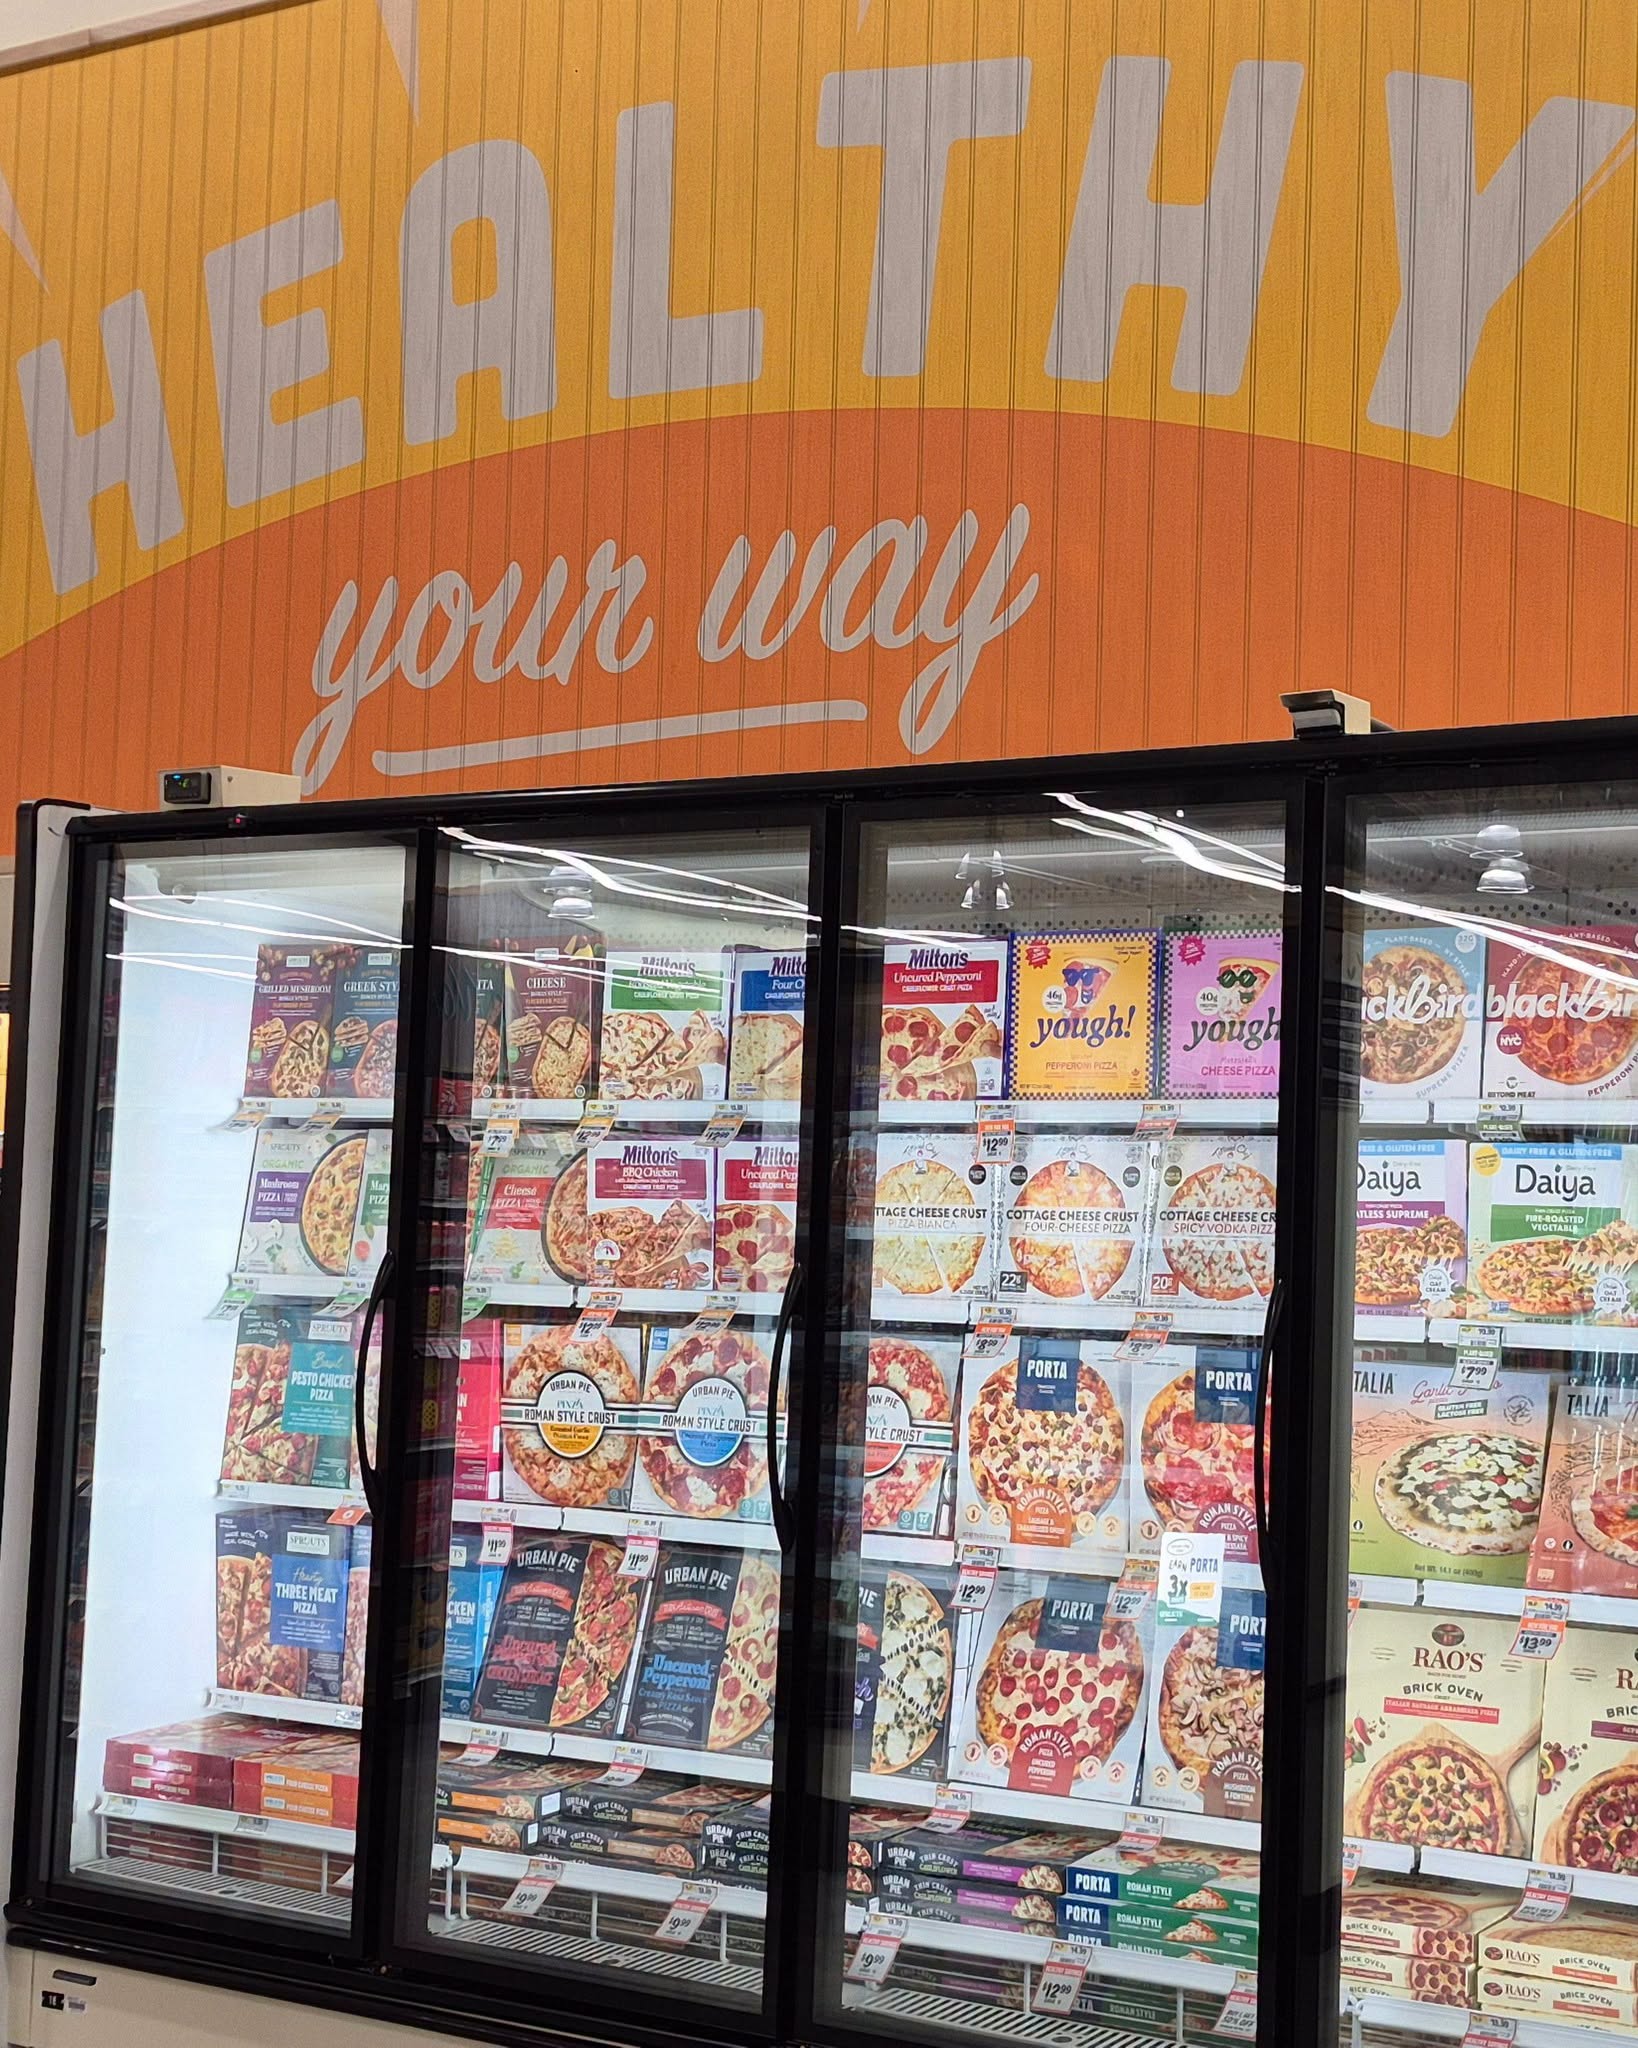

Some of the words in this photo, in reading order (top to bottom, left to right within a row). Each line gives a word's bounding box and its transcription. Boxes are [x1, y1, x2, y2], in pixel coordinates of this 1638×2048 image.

[16, 55, 1633, 596] HEALTHY
[291, 538, 653, 798] your
[697, 502, 1039, 757] way
[905, 949, 969, 970] Milton's
[526, 977, 567, 989] CHEESE
[772, 979, 793, 989] Four
[894, 972, 933, 983] Uncured
[935, 971, 982, 984] Pepperoni
[344, 981, 371, 992] GREEK
[1030, 1004, 1136, 1048] yough!
[1046, 1062, 1092, 1070] PEPPERONI
[1094, 1062, 1118, 1070] PIZZA
[1201, 1066, 1243, 1076] CHEESE
[1245, 1066, 1276, 1076] PIZZA
[1587, 1063, 1634, 1097] PEPPERONI
[621, 1145, 679, 1166] Milton's
[262, 1160, 304, 1169] ORGANIC
[503, 1164, 549, 1175] ORGANIC
[622, 1168, 642, 1178] BBQ
[644, 1168, 679, 1178] Chicken
[741, 1169, 779, 1179] Uncured
[259, 1178, 299, 1189] Mushroom
[504, 1183, 538, 1196] Cheese
[1515, 1164, 1596, 1202] Daiya
[257, 1192, 281, 1202] PIZZA
[494, 1197, 521, 1208] PIZZA
[909, 1208, 950, 1218] CHEESE
[952, 1208, 987, 1219] CRUST
[1006, 1209, 1056, 1221] COTTAGE
[1058, 1209, 1100, 1221] CHEESE
[1104, 1211, 1139, 1222] CRUST
[1159, 1210, 1210, 1221] COTTAGE
[1213, 1211, 1258, 1222] CHEESE
[1386, 1209, 1429, 1219] SUPREME
[1525, 1215, 1584, 1224] FIRE-ROASTED
[888, 1219, 915, 1229] PIZZA
[917, 1219, 957, 1229] BIANCA
[1025, 1221, 1100, 1233] FOUR-CHEESE
[1103, 1223, 1131, 1233] PIZZA
[1174, 1222, 1205, 1233] SPICY
[1207, 1223, 1247, 1234] VODKA
[1531, 1223, 1578, 1232] VEGETABLE
[1027, 1359, 1067, 1379] PORTA
[291, 1371, 318, 1387] PESTO
[1206, 1370, 1252, 1391] PORTA
[1353, 1371, 1394, 1394] TALIA
[550, 1381, 576, 1391] URBAN
[578, 1381, 592, 1393] PIE
[692, 1385, 719, 1397] URBAN
[721, 1387, 736, 1400] PIE
[310, 1388, 334, 1401] PIZZA
[884, 1396, 899, 1409] PIE
[1437, 1403, 1465, 1411] GLUTEN
[1466, 1401, 1483, 1409] FREE
[1568, 1395, 1608, 1417] TALIA
[525, 1409, 554, 1421] ROMAN
[557, 1410, 585, 1423] STYLE
[588, 1411, 616, 1424] CRUST
[662, 1415, 694, 1427] ROMAN
[696, 1416, 725, 1430] STYLE
[728, 1419, 757, 1432] CRUST
[890, 1428, 922, 1442] CRUST
[1017, 1487, 1045, 1512] ROMAN
[1045, 1489, 1068, 1514] STYLE
[1200, 1503, 1231, 1528] ROMAN
[1233, 1504, 1257, 1531] STYLE
[289, 1535, 327, 1547] SPROUTS
[517, 1549, 557, 1568] URBAN
[558, 1552, 581, 1574] PIE
[1169, 1559, 1187, 1572] EARN
[1190, 1558, 1218, 1573] PORTA
[665, 1567, 709, 1585] URBAN
[709, 1569, 732, 1591] PIE
[275, 1582, 307, 1601] THREE
[309, 1586, 338, 1604] MEAT
[293, 1602, 317, 1615] PIZZA
[1051, 1599, 1094, 1621] PORTA
[654, 1654, 711, 1676] Uncured
[1412, 1646, 1483, 1673] RAO'S
[641, 1667, 713, 1691] Pepperoni
[1403, 1682, 1443, 1695] BRICK
[1447, 1684, 1483, 1702] OVEN
[658, 1702, 682, 1712] PIZZA
[1020, 1728, 1052, 1753] ROMAN
[1052, 1730, 1073, 1759] STYLE
[1038, 1748, 1053, 1756] PIZZA
[1212, 1750, 1245, 1777] ROMAN
[1232, 1772, 1249, 1780] PIZZA
[565, 1797, 590, 1810] URBAN
[571, 1805, 583, 1815] PIE
[542, 1826, 566, 1838] URBAN
[706, 1824, 733, 1838] URBAN
[548, 1835, 559, 1844] PIE
[712, 1834, 724, 1844] PIE
[709, 1848, 736, 1862] URBAN
[887, 1847, 916, 1861] URBAN
[919, 1852, 936, 1863] THIN
[938, 1853, 959, 1867] CRUST
[715, 1857, 727, 1868] PIE
[894, 1857, 907, 1867] PIE
[919, 1863, 958, 1875] CAULIFLOWER
[882, 1875, 911, 1889] URBAN
[914, 1881, 930, 1891] THIN
[931, 1881, 953, 1896] CRUST
[1075, 1873, 1111, 1894] PORTA
[1126, 1881, 1151, 1893] ROMAN
[1152, 1885, 1173, 1897] STYLE
[889, 1885, 902, 1895] PIE
[885, 1901, 914, 1915] URBAN
[917, 1908, 933, 1918] THIN
[1065, 1904, 1101, 1925] PORTA
[1116, 1912, 1142, 1925] ROMAN
[1142, 1916, 1162, 1929] STYLE
[1346, 1923, 1369, 1931] BRICK
[1371, 1924, 1394, 1936] OVEN
[1505, 1948, 1541, 1964] RAO'S
[1364, 1957, 1387, 1970] OVEN
[1559, 1957, 1584, 1966] BRICK
[1587, 1959, 1611, 1972] OVEN
[1505, 1984, 1541, 1999] RAO'S
[1560, 1991, 1585, 2000] BRICK
[1588, 1993, 1612, 2006] OVEN
[1109, 2003, 1135, 2017] ROMAN
[1136, 2006, 1157, 2020] STYLE
